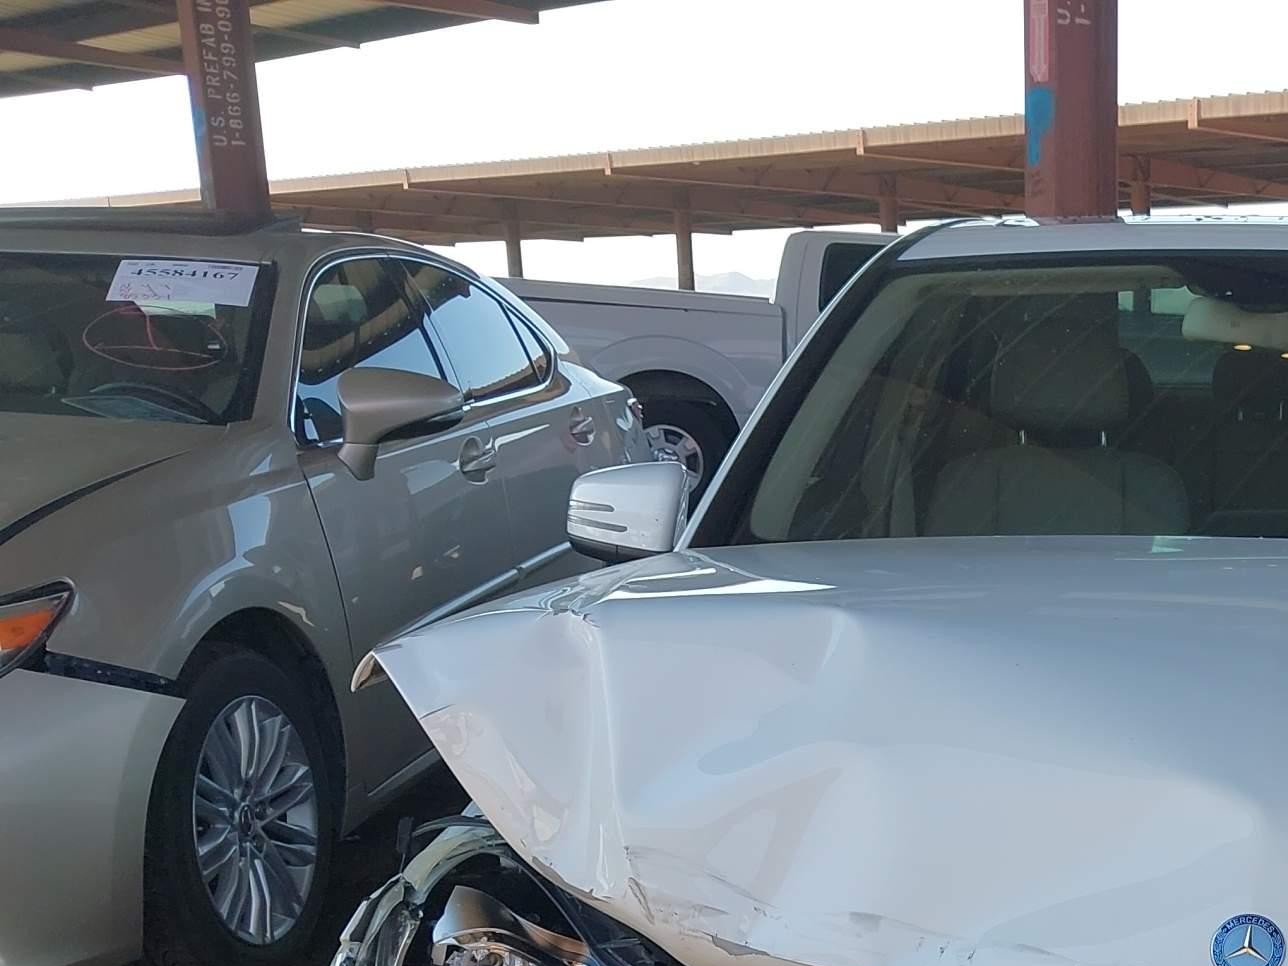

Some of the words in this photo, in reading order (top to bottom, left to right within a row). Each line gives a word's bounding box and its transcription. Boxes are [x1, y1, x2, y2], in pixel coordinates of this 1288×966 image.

[200, 23, 222, 99] PREFAB
[131, 268, 240, 280] 45584167
[1225, 916, 1275, 933] MERCEDES
